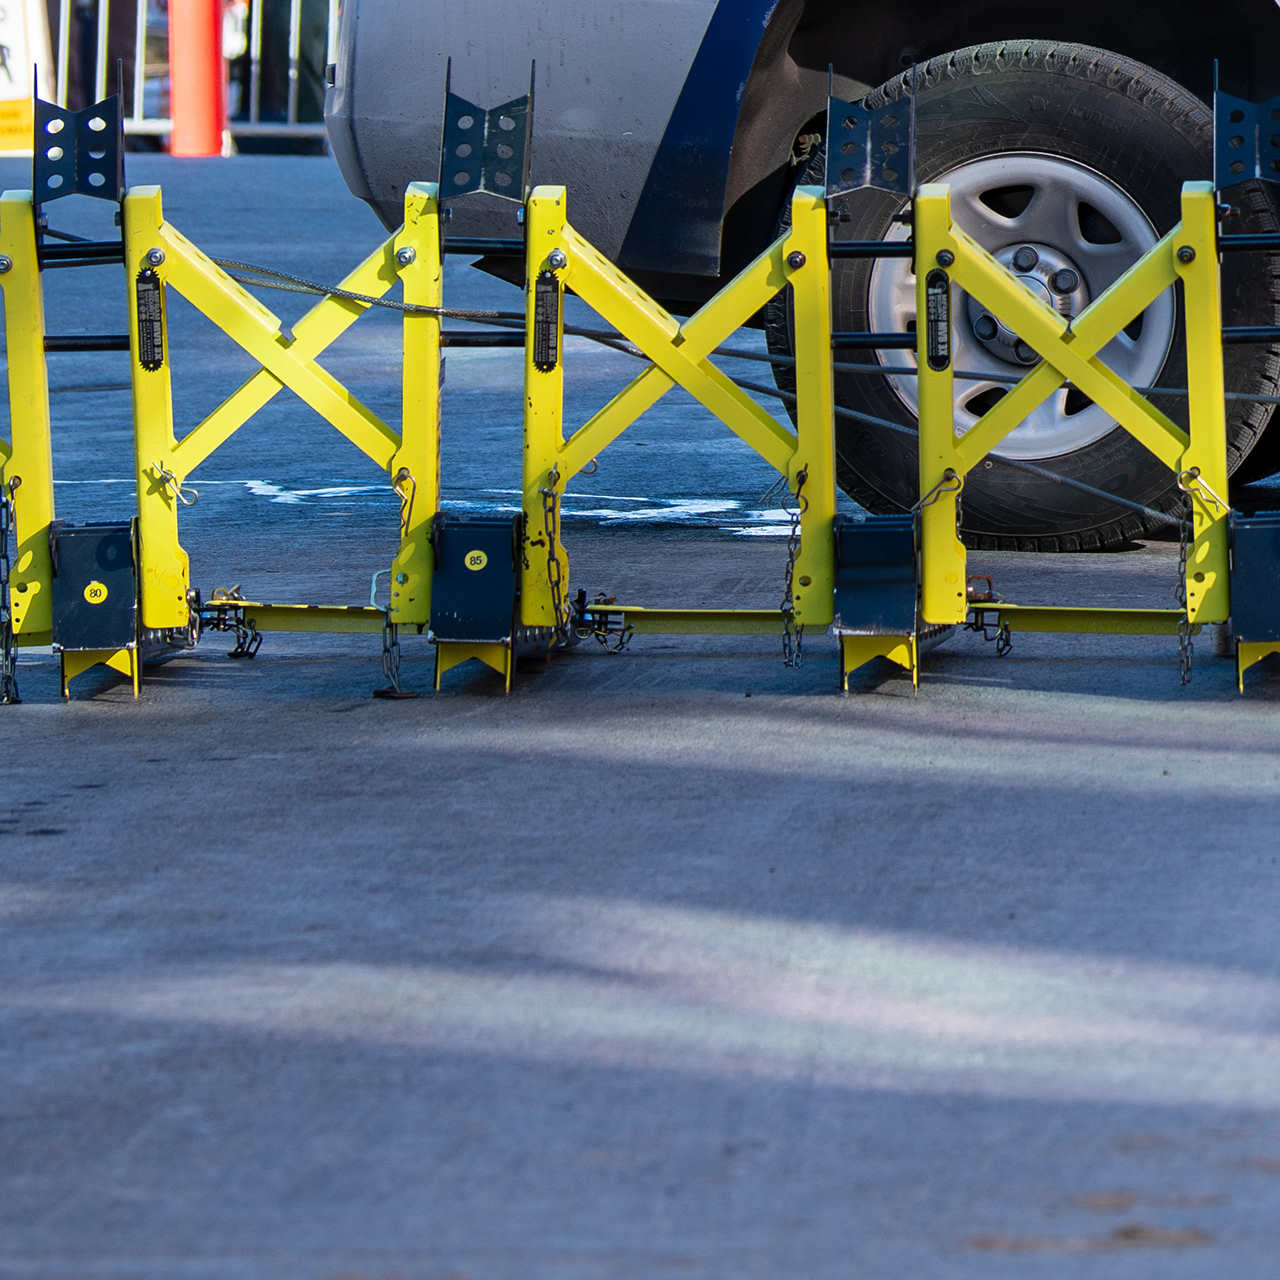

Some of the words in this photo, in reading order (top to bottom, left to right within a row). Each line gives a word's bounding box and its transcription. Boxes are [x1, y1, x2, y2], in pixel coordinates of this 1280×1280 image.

[153, 322, 161, 345] MVB
[549, 324, 557, 347] MVB
[938, 322, 947, 342] MVB
[154, 347, 162, 360] 3X
[549, 348, 556, 362] 3X
[938, 344, 948, 356] 3X
[469, 555, 482, 566] 85
[89, 587, 102, 599] 80
